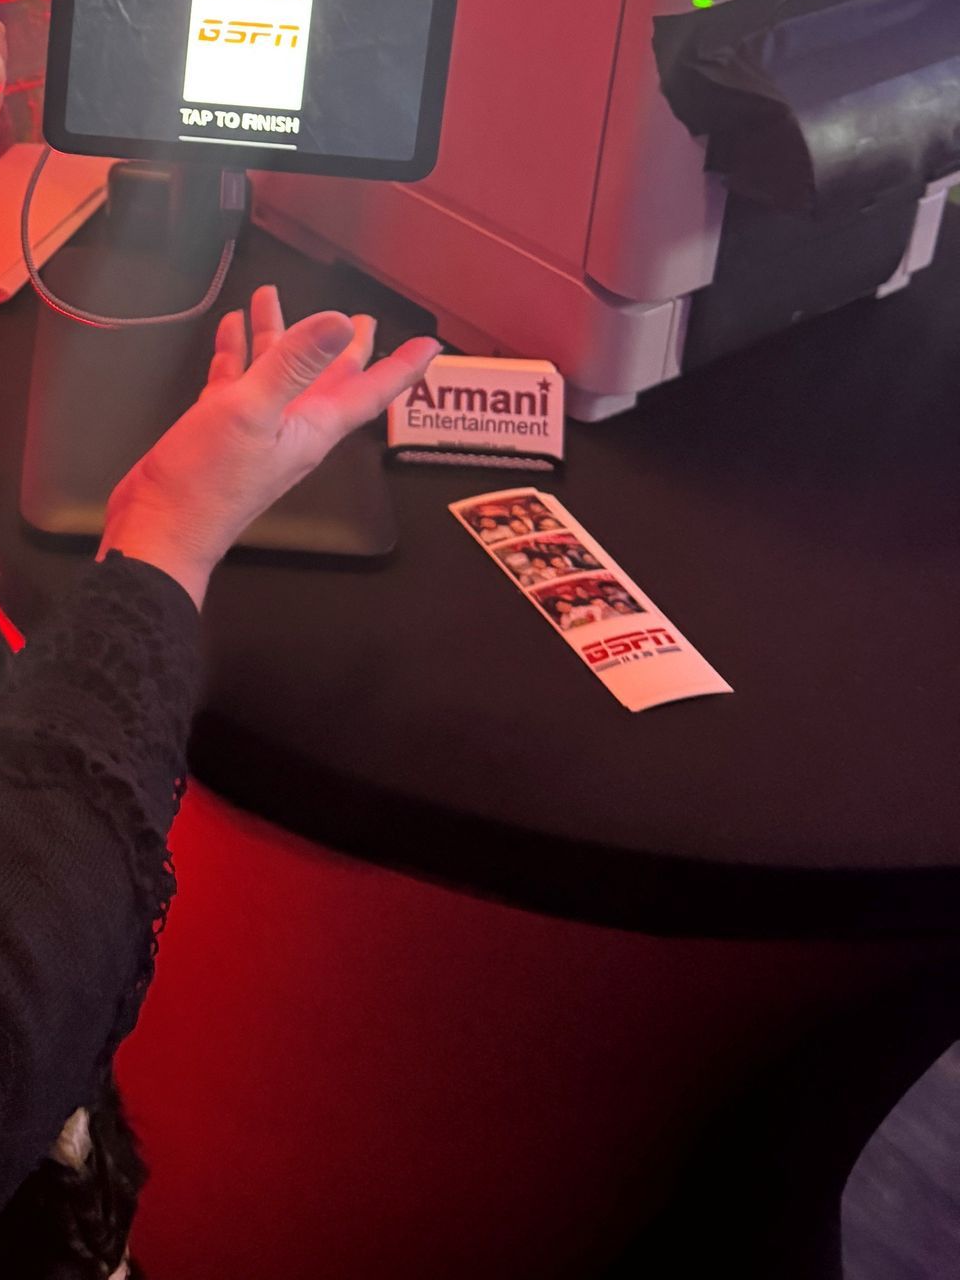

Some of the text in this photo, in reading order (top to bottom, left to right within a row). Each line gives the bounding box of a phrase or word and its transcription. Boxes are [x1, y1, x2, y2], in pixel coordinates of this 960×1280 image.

[179, 107, 301, 134] TAP TO FINISH
[405, 376, 552, 417] Armani
[407, 409, 550, 437] Entertainment
